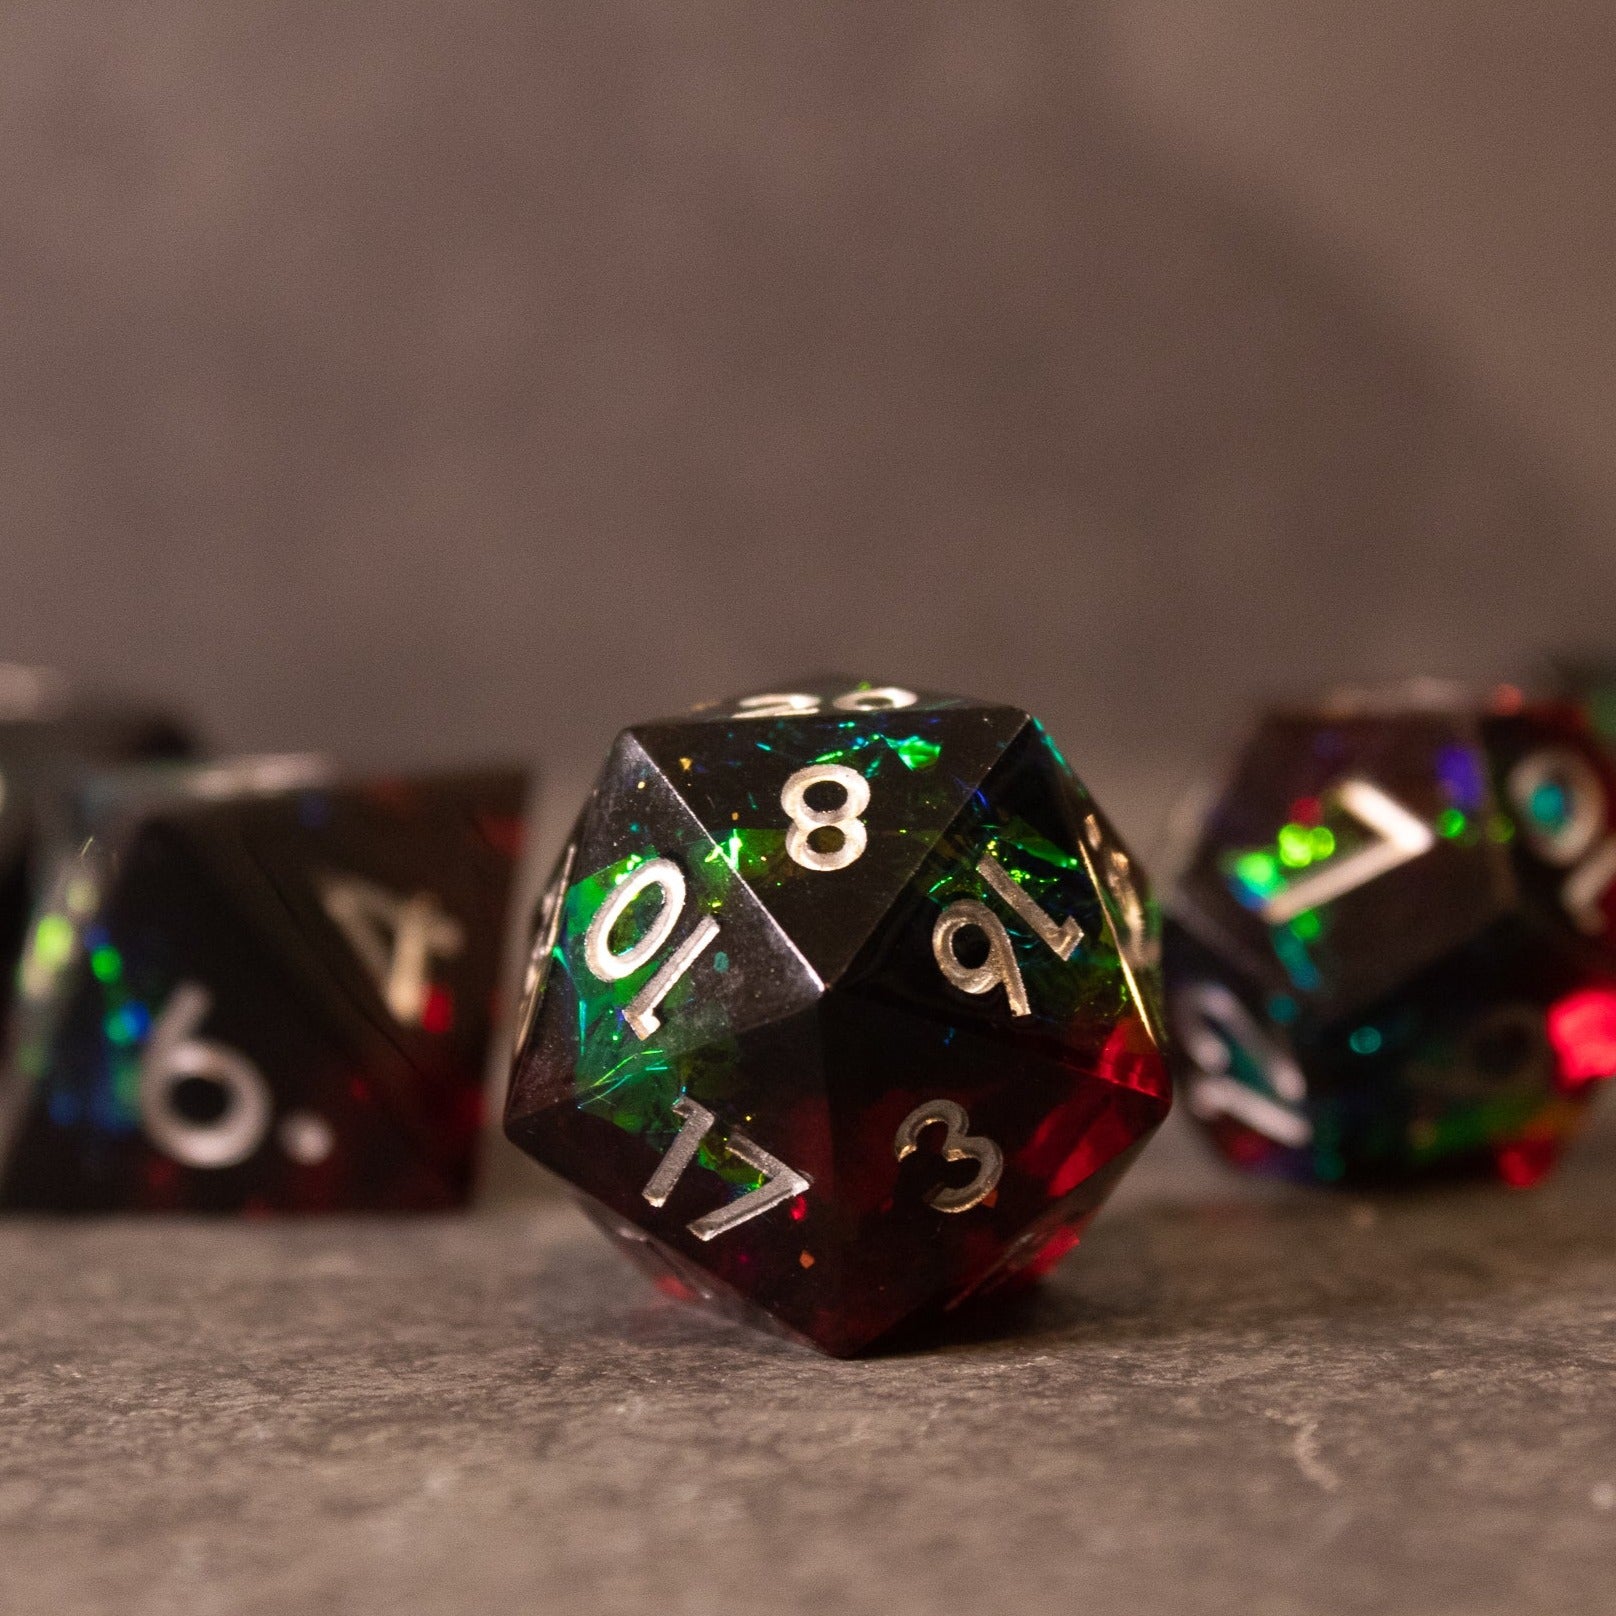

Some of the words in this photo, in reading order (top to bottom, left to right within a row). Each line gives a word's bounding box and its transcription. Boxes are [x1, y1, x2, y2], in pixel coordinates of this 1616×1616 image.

[781, 763, 870, 871] 8
[1264, 778, 1432, 923] 7
[318, 870, 463, 1022] 4
[585, 857, 720, 1041] 10
[642, 1096, 811, 1241] 17
[895, 1100, 1004, 1213] 3
